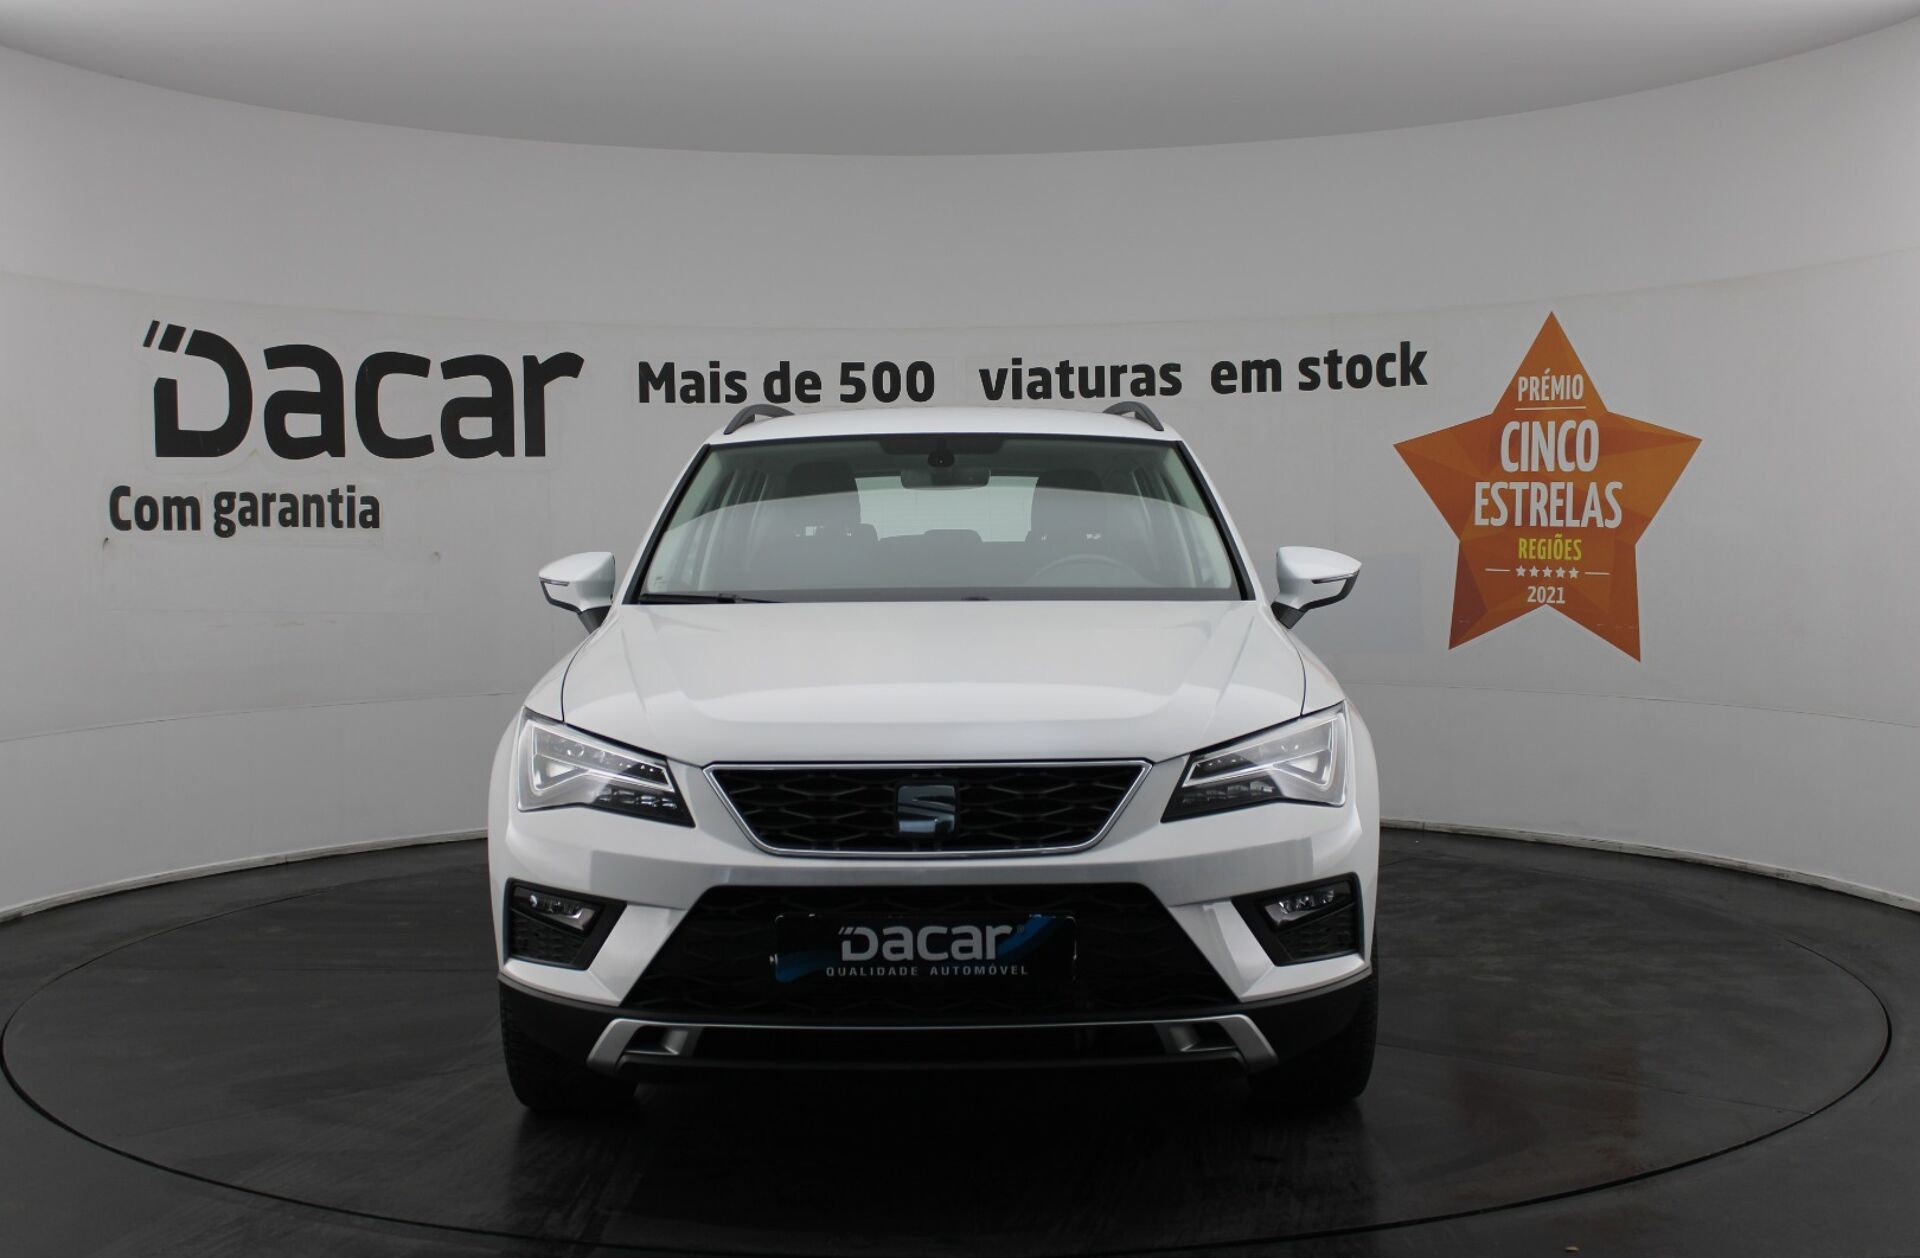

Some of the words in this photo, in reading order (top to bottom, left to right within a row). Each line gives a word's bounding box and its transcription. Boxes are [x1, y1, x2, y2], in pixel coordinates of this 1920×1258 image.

[142, 319, 585, 460] Dacar
[638, 360, 748, 405] Mais
[762, 360, 822, 404] de
[839, 361, 935, 404] 500
[978, 357, 1183, 401] viaturas
[1210, 358, 1282, 395] em
[1298, 340, 1429, 391] stock
[1517, 368, 1584, 402] PRÉMIO
[1500, 419, 1600, 473] CINCO
[109, 485, 202, 532] Com
[213, 485, 381, 539] garantia
[1474, 481, 1623, 529] ESTRELAS
[1518, 534, 1582, 561] REGIÕES
[1527, 586, 1566, 604] 2021
[838, 924, 1013, 962] Dacar
[826, 966, 918, 976] QUALIDADE
[930, 963, 1028, 976] AUTOMÓVEL
